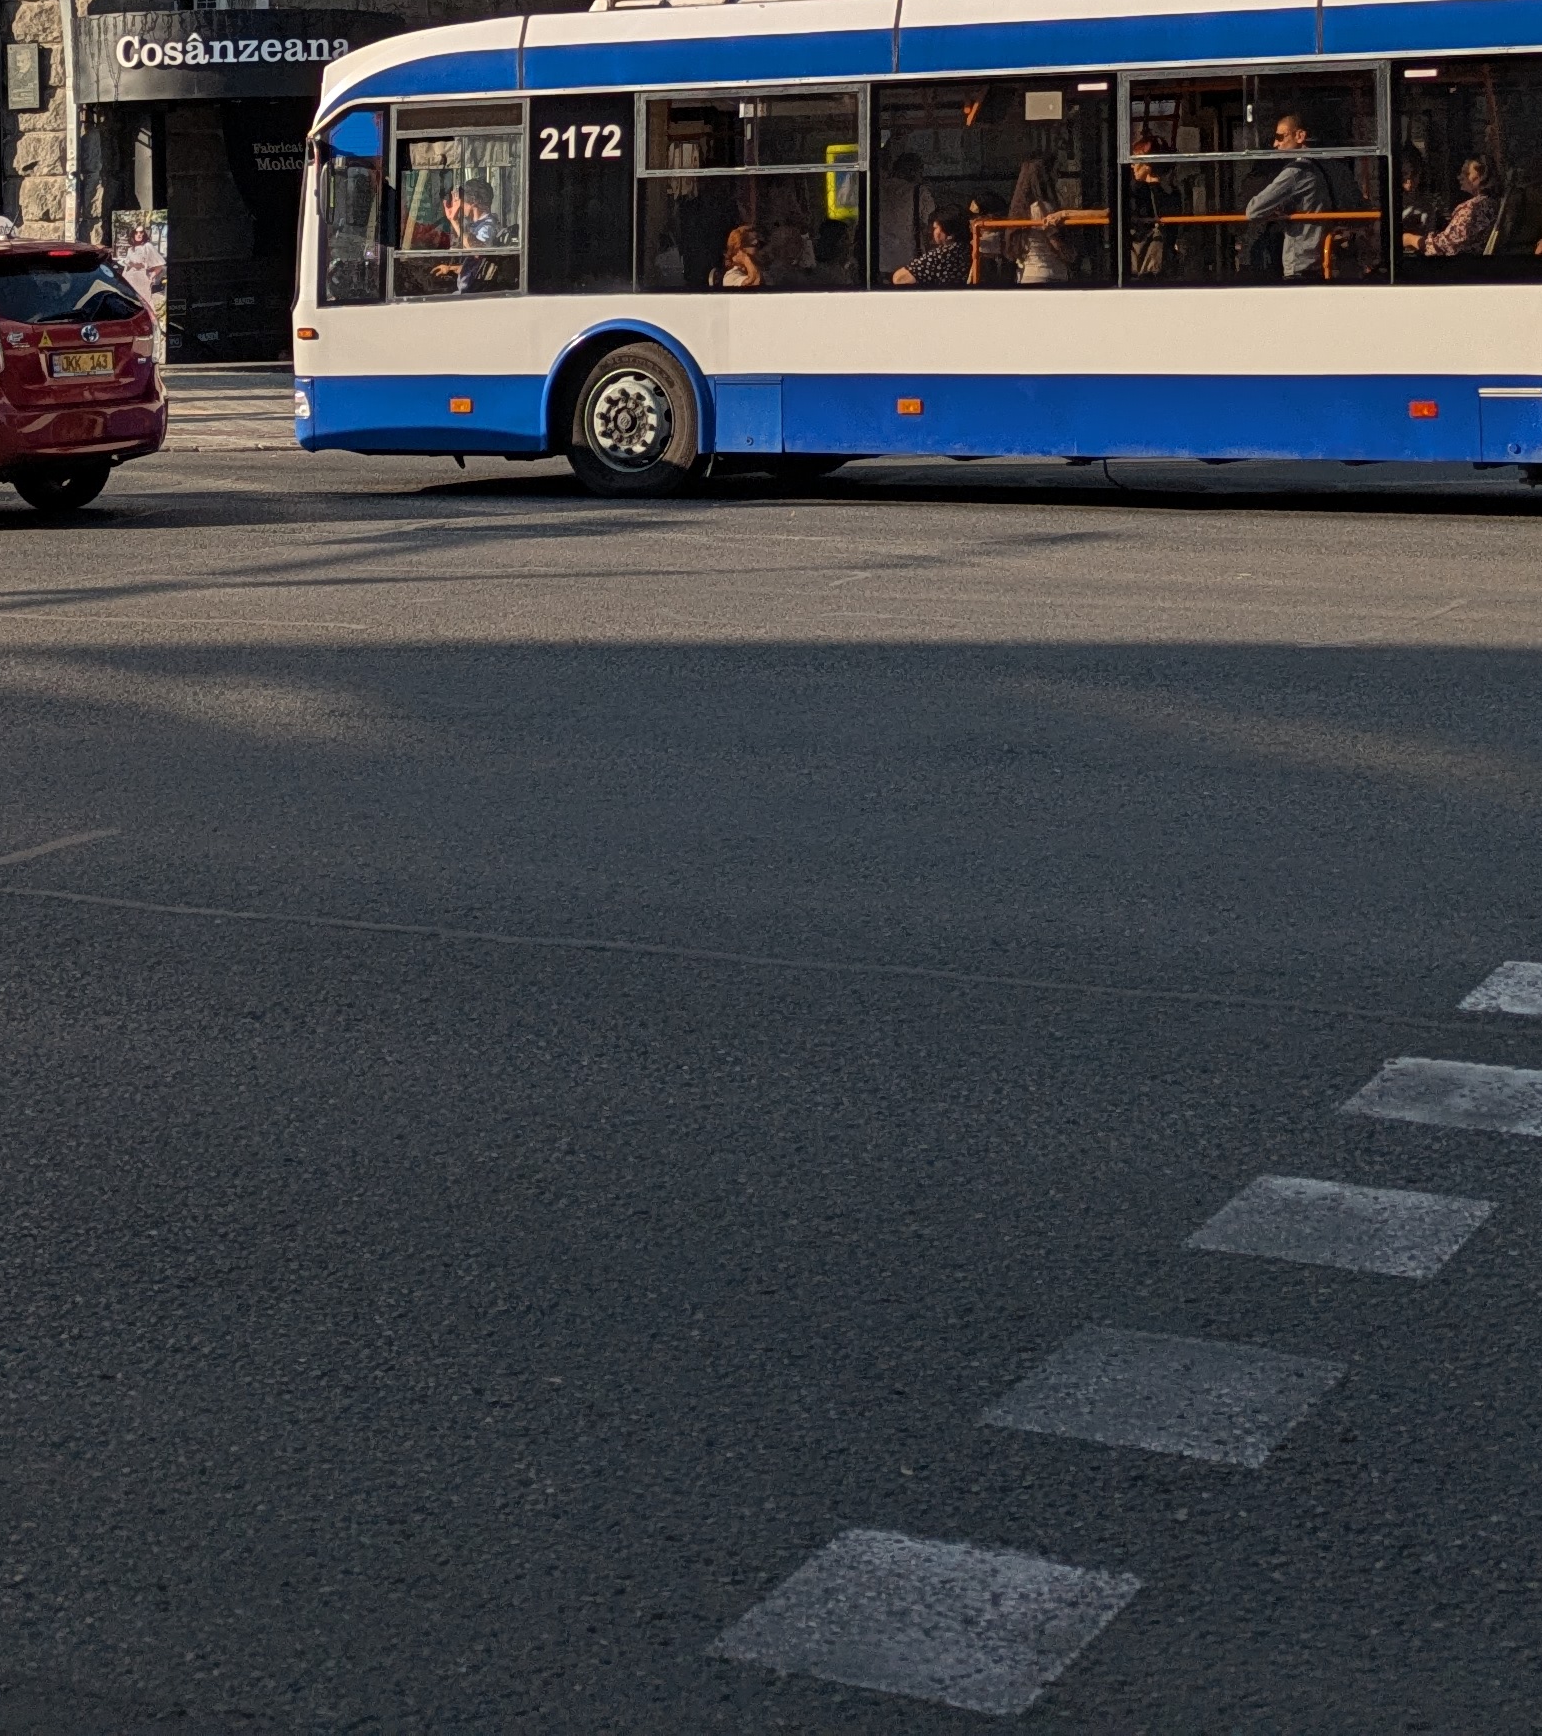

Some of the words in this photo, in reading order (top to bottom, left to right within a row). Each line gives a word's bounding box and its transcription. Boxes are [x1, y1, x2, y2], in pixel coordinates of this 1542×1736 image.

[116, 33, 349, 68] Cosânzeana
[252, 142, 303, 154] Fabricat
[539, 124, 621, 160] 2172
[255, 157, 304, 171] Moldo
[62, 355, 81, 371] JKK
[90, 354, 108, 370] 143
